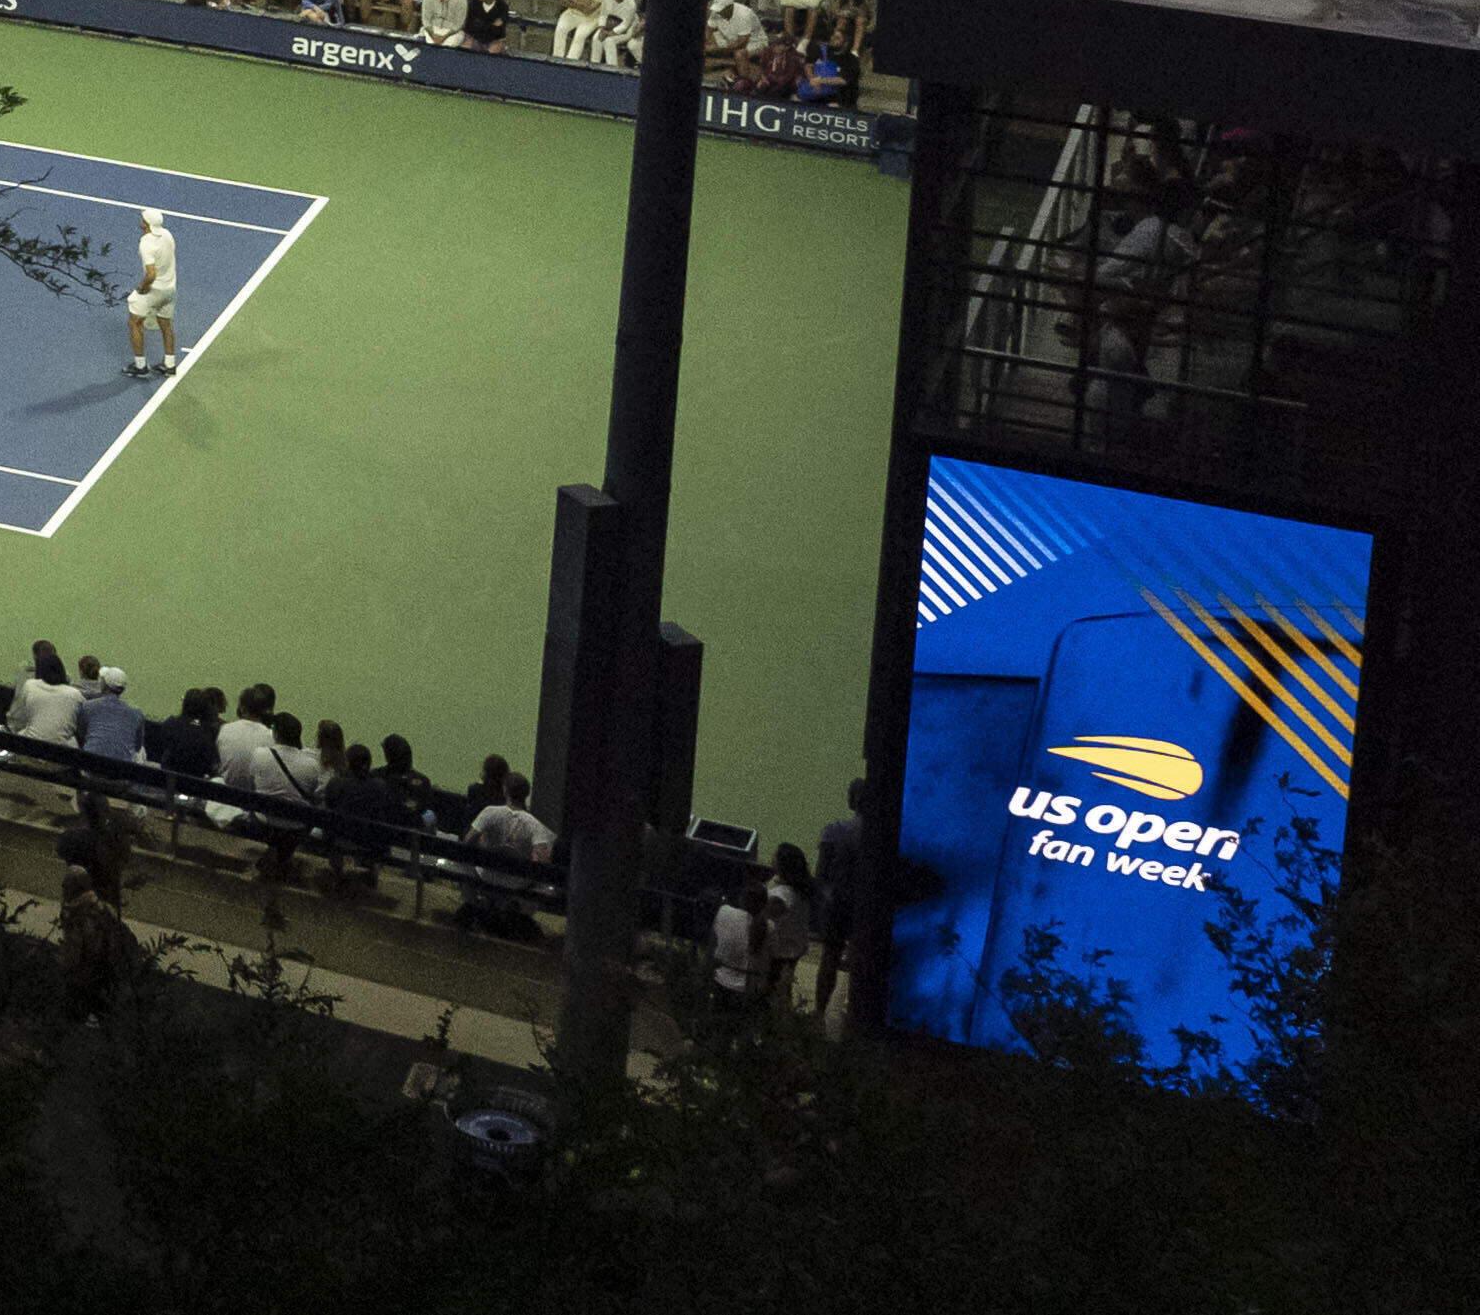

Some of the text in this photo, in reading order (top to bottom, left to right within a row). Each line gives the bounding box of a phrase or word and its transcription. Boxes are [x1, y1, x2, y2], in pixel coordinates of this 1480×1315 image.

[292, 37, 394, 71] argenx
[705, 96, 784, 132] IHG
[794, 110, 869, 132] HOTELS
[1008, 786, 1241, 861] us open
[1028, 829, 1212, 893] fan week
